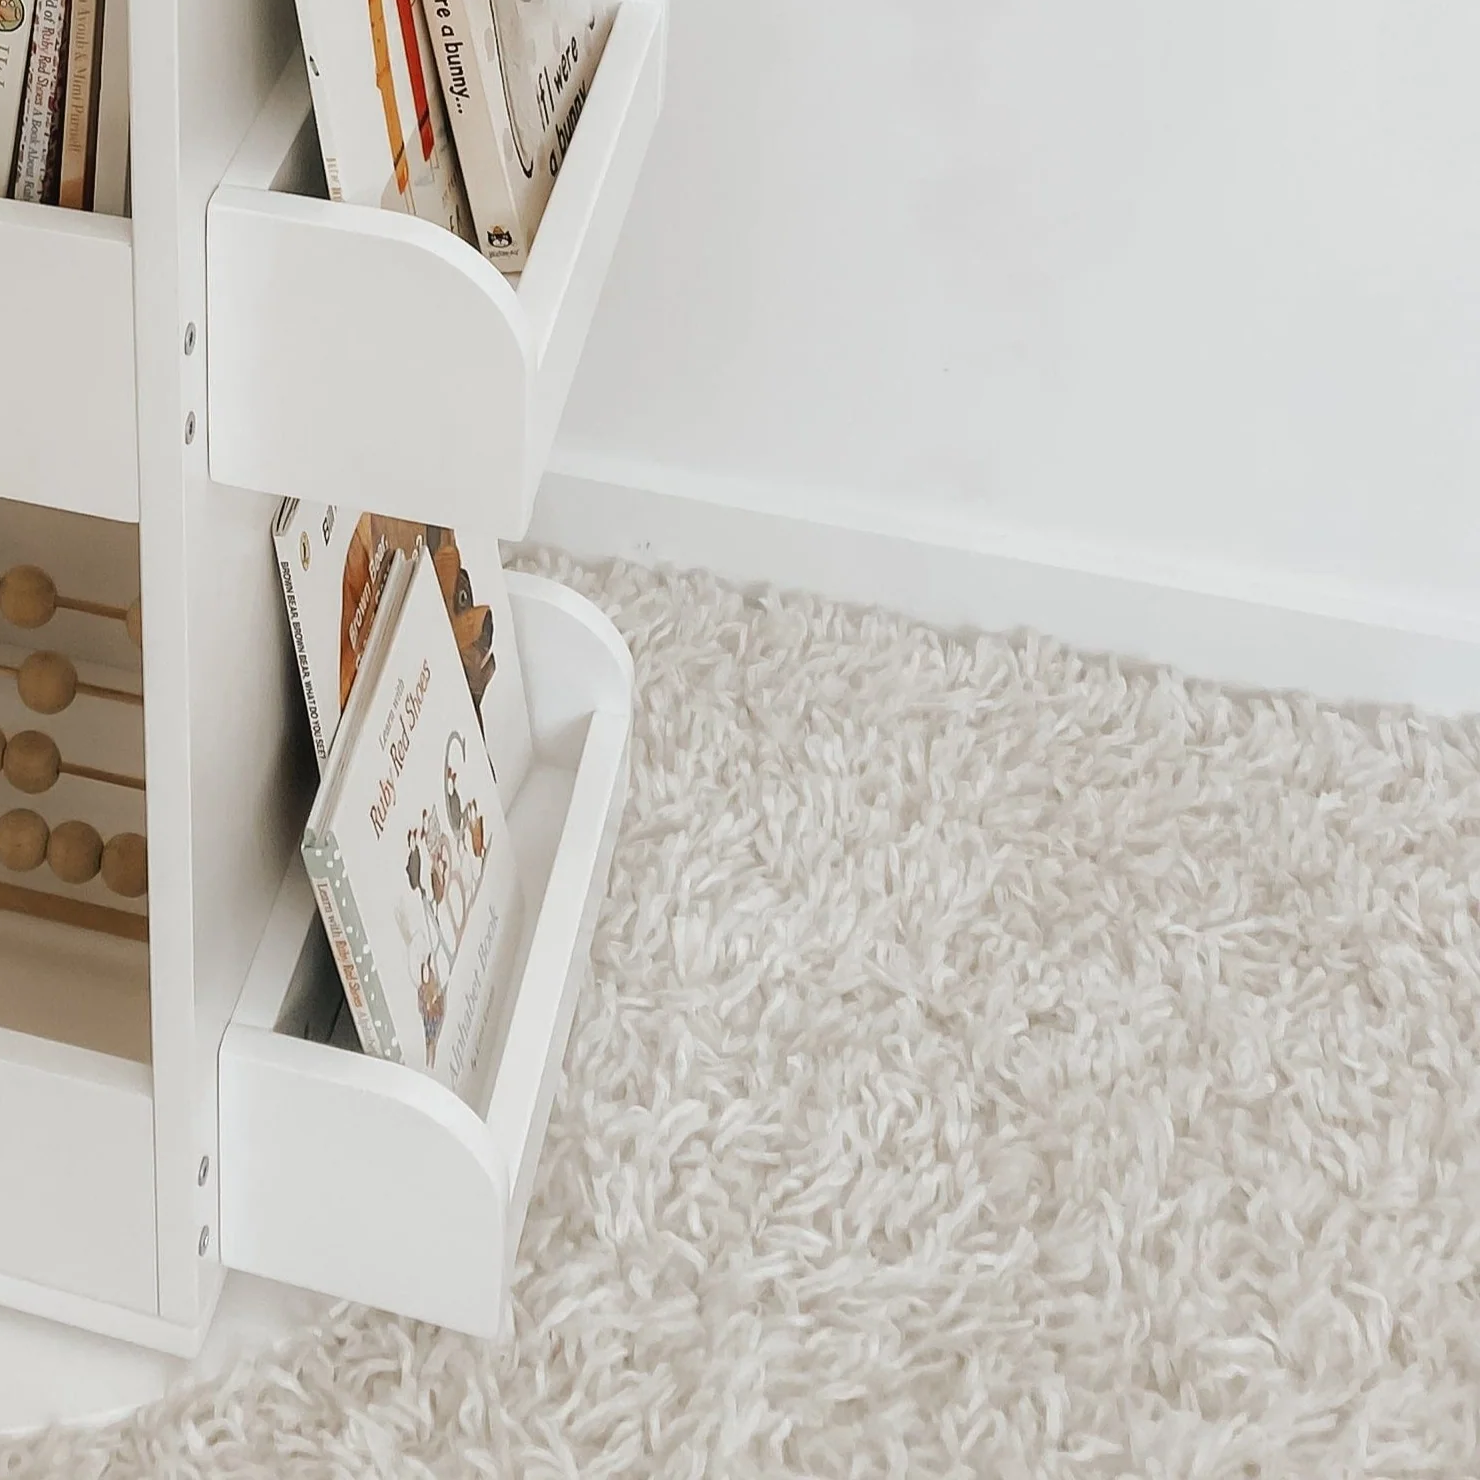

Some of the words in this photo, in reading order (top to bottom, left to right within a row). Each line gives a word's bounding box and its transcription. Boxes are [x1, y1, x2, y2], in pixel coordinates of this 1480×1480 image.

[44, 10, 55, 25] of
[441, 24, 455, 37] a
[41, 26, 55, 53] Ruby
[38, 55, 51, 76] Red
[445, 42, 470, 115] bunny...
[554, 36, 578, 94] were
[34, 76, 49, 106] Shoes
[30, 120, 42, 147] Book
[549, 149, 559, 177] a
[281, 561, 293, 593] BROWN
[349, 581, 371, 651] Brown
[293, 622, 305, 653] BROWN
[304, 681, 316, 706] WHAT
[309, 706, 318, 719] DO
[378, 708, 395, 752] Learn
[392, 677, 406, 711] with
[370, 767, 397, 841] Ruby
[390, 713, 410, 777] Red
[404, 658, 431, 732] Shoes
[317, 883, 331, 913] Learn
[328, 915, 342, 939] with
[477, 904, 499, 974] Book
